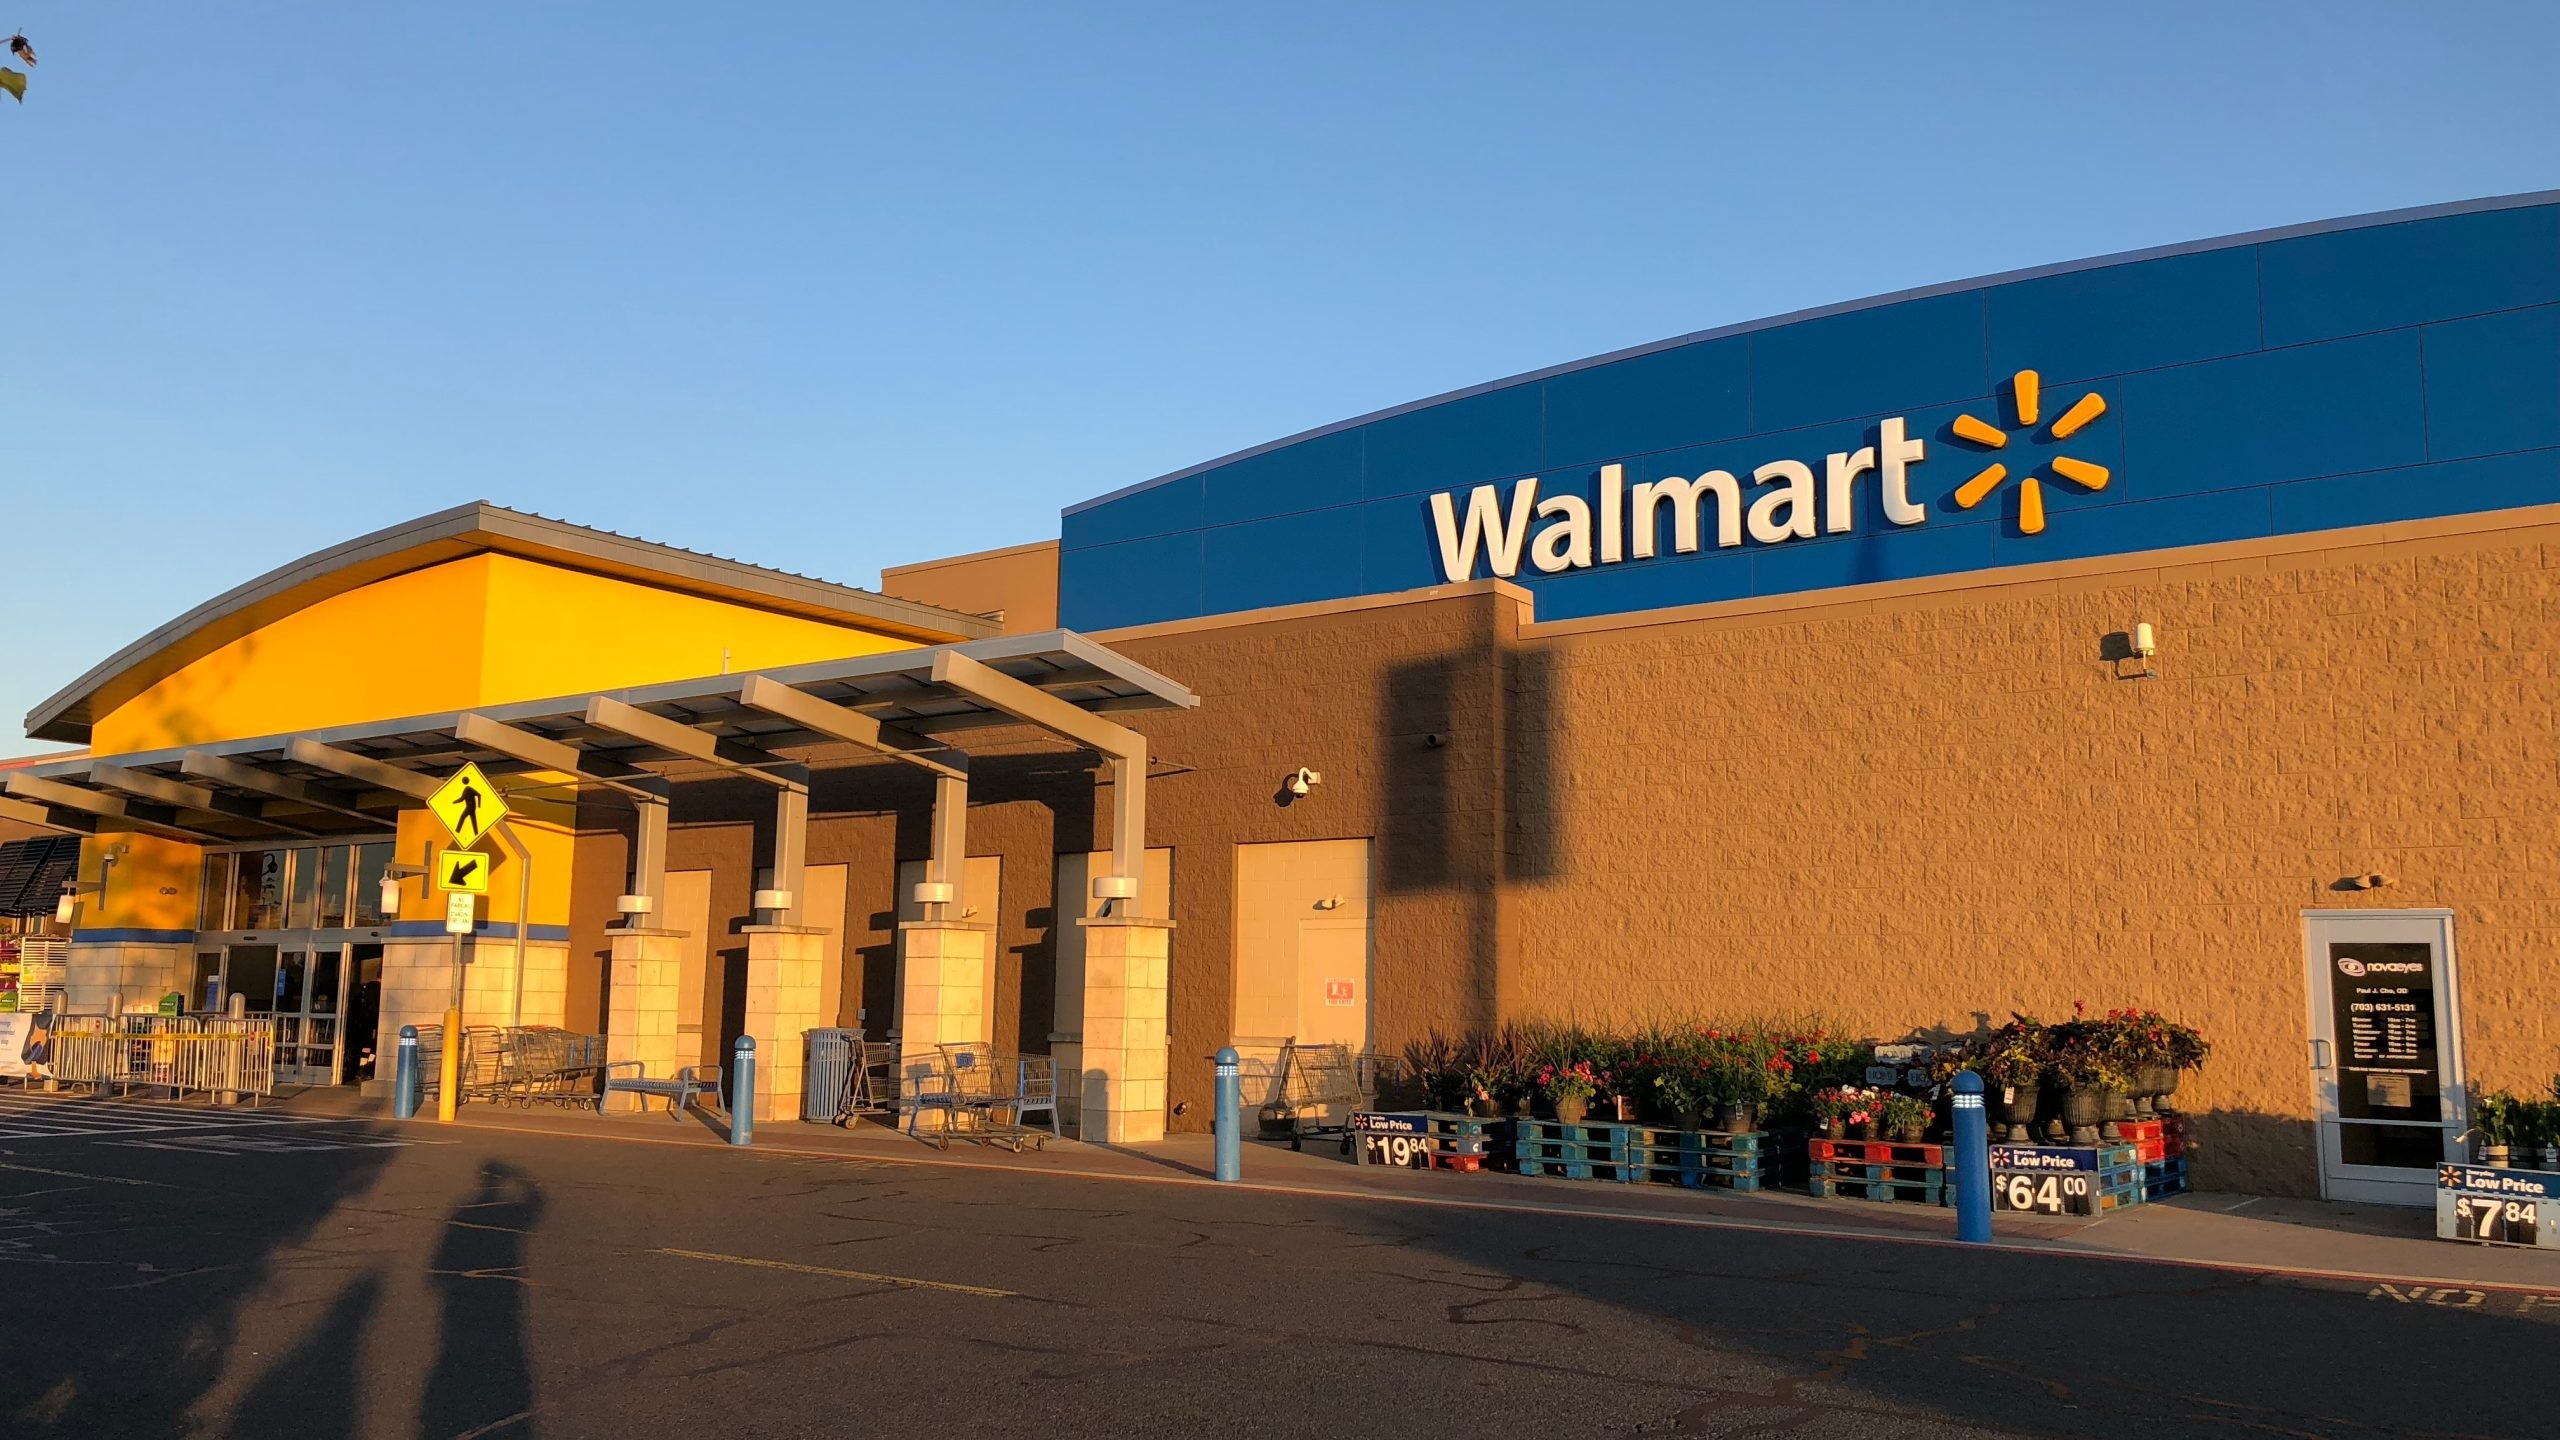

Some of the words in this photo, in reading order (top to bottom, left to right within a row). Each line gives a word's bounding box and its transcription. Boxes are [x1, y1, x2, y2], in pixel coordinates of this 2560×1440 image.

[1430, 416, 1925, 583] Walmart
[2367, 963, 2424, 974] novaeyes
[2350, 1003, 2374, 1013] (703)
[2375, 1004, 2416, 1012] 631-5131
[1370, 1119, 1389, 1129] Low
[1390, 1120, 1413, 1131] Price
[2013, 1154, 2040, 1167] Low
[2042, 1155, 2075, 1168] Price
[2466, 1174, 2500, 1190] Low
[2502, 1177, 2545, 1194] Price
